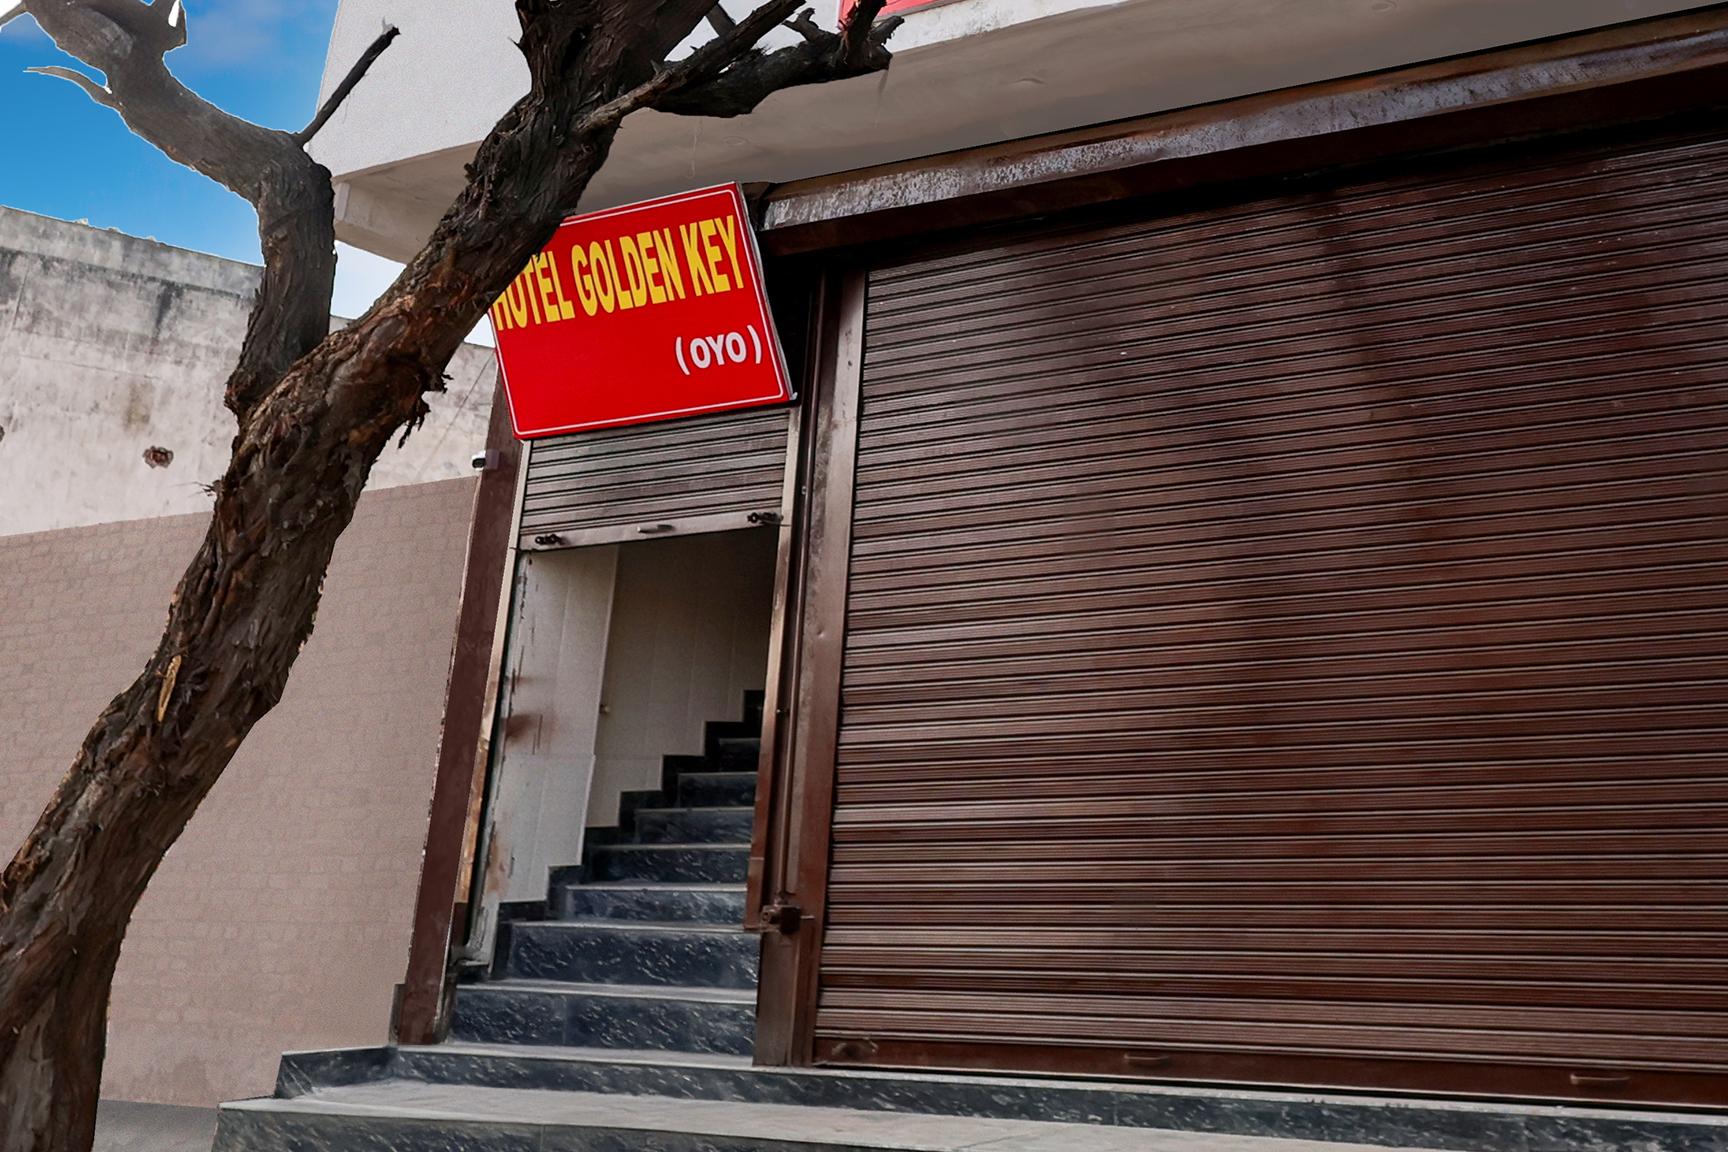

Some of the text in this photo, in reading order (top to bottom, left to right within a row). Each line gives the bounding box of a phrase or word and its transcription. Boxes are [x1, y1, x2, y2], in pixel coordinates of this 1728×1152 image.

[571, 227, 686, 317] GOLDEN
[679, 214, 744, 297] KEY
[675, 324, 762, 376] (OYO)
